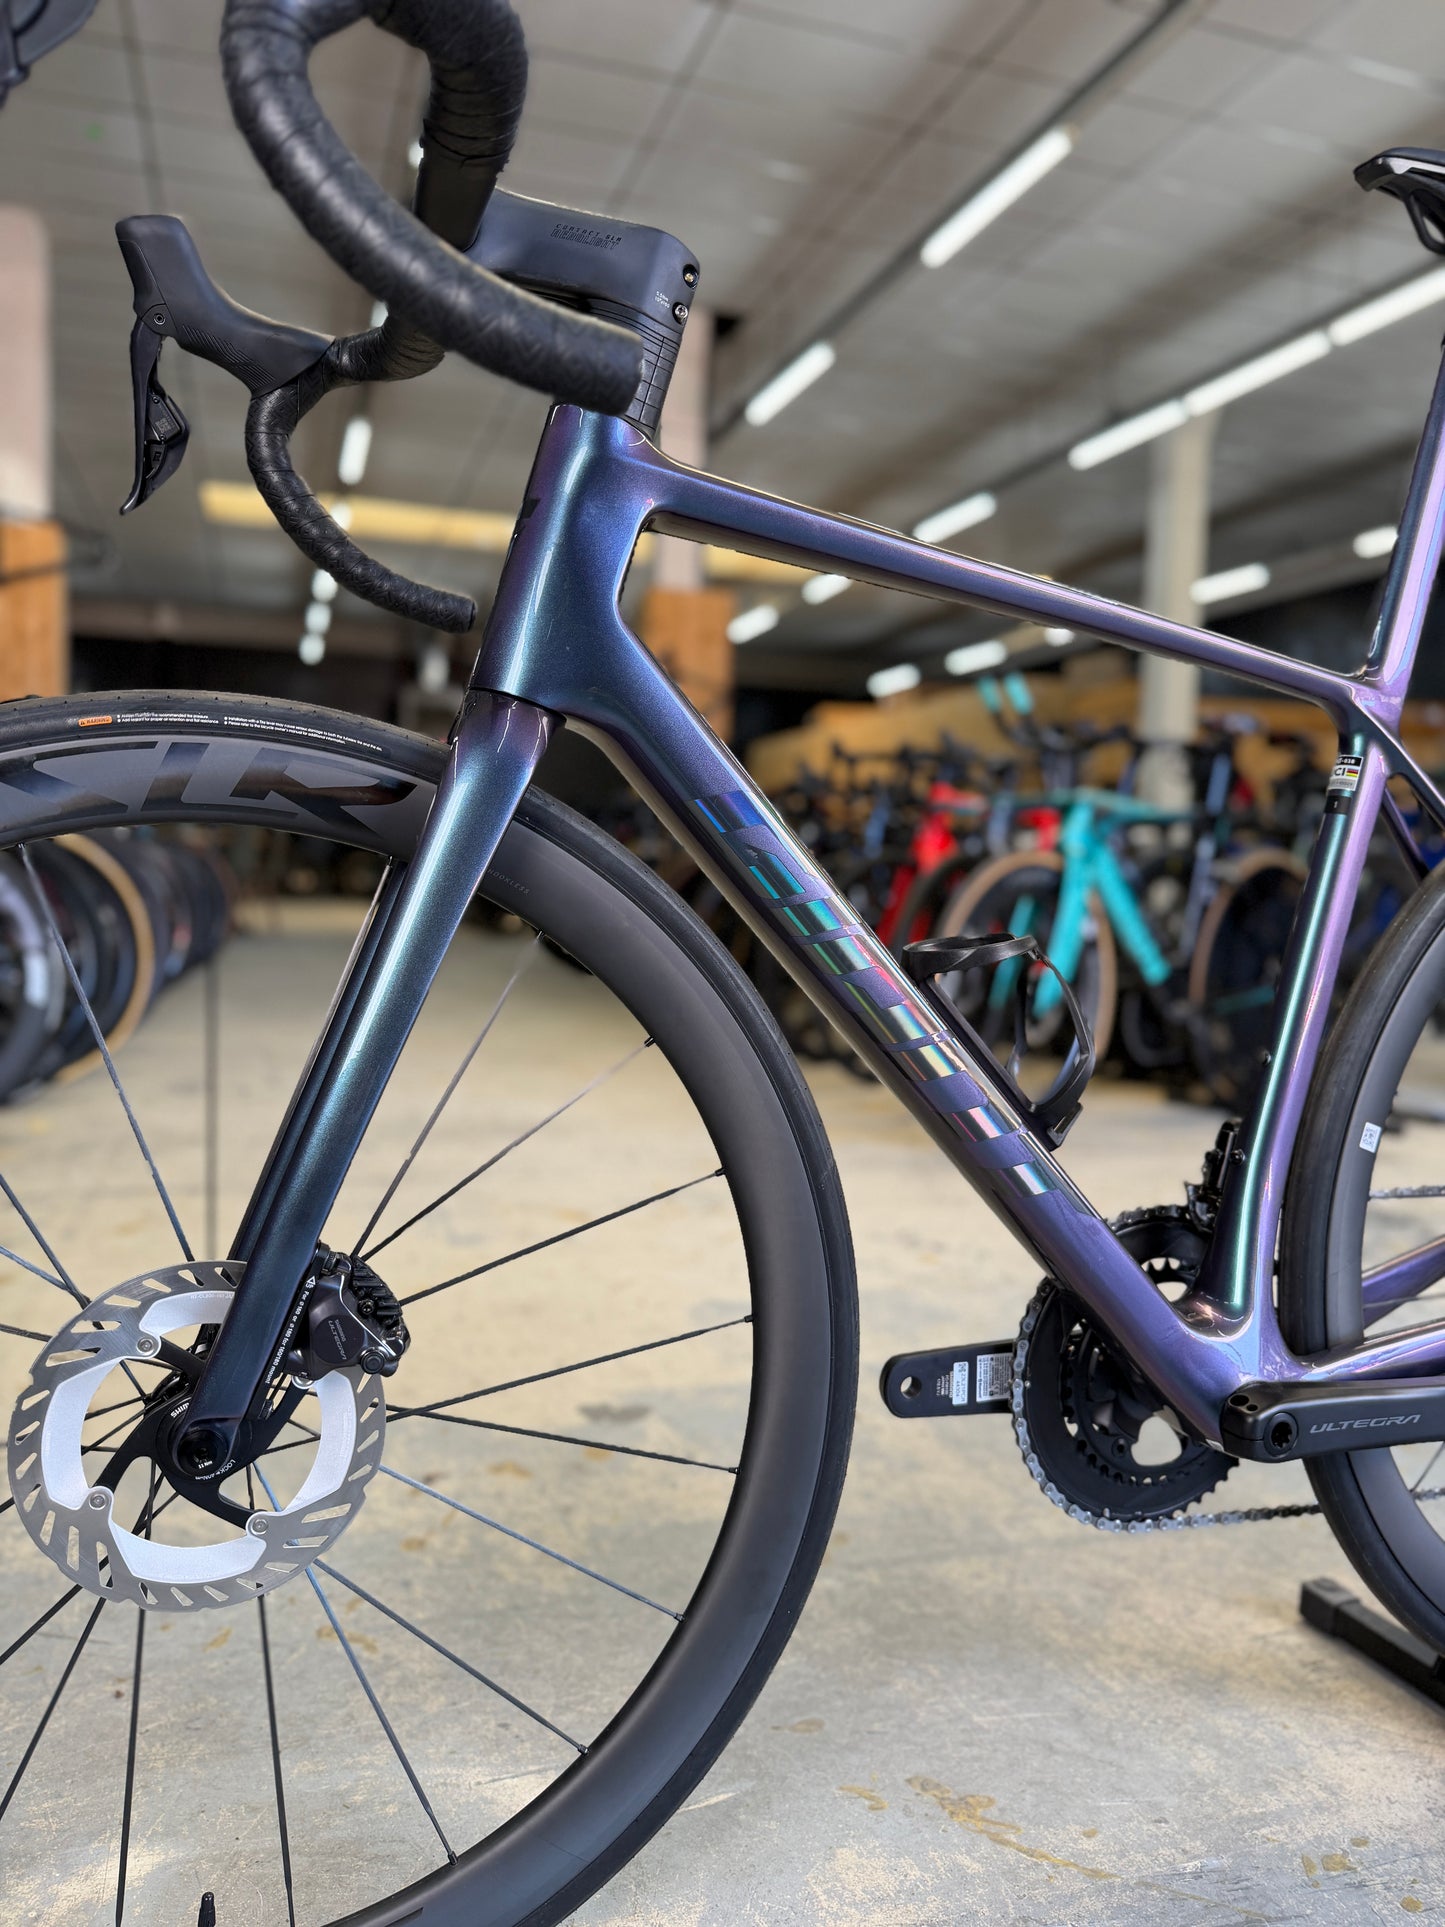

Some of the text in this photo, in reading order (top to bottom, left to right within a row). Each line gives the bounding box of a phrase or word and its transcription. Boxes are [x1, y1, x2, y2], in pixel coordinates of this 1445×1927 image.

[555, 223, 600, 237] CONTACT
[487, 868, 531, 895] HOOKLESS
[686, 786, 1104, 1222] GIANT
[302, 1290, 310, 1300] For
[281, 1336, 289, 1345] for
[327, 1320, 348, 1361] ULTEGRA
[265, 1365, 276, 1384] mount
[170, 1402, 190, 1418] SHIM
[1309, 1414, 1422, 1434] ULTEGRA
[220, 1459, 236, 1474] LOCK
